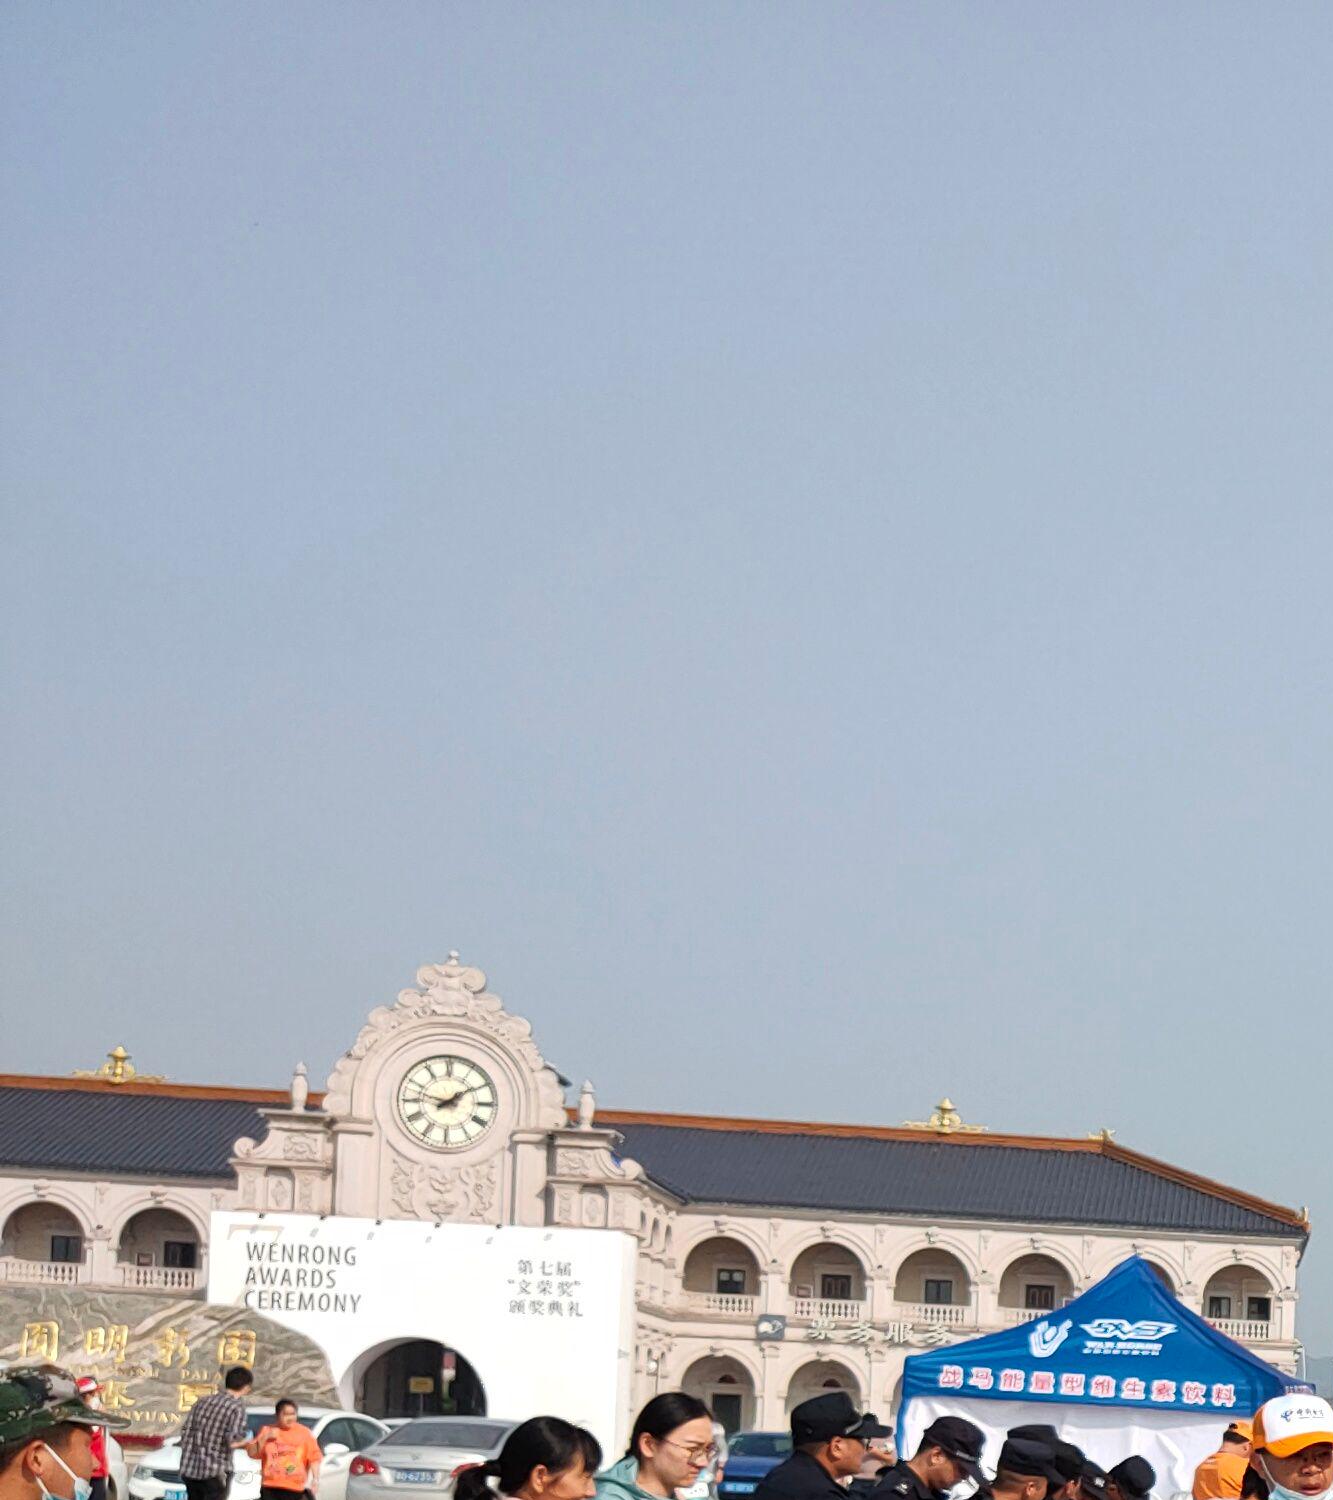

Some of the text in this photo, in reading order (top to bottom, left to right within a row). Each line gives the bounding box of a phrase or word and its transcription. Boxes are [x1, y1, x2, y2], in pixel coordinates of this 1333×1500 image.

[246, 1242, 357, 1266] WENRONG
[245, 1267, 336, 1288] AWARDS
[518, 1260, 572, 1276] 第七届
[245, 1290, 361, 1313] CEREMONY
[939, 1364, 1237, 1408] 战马能量型维生素饮料
